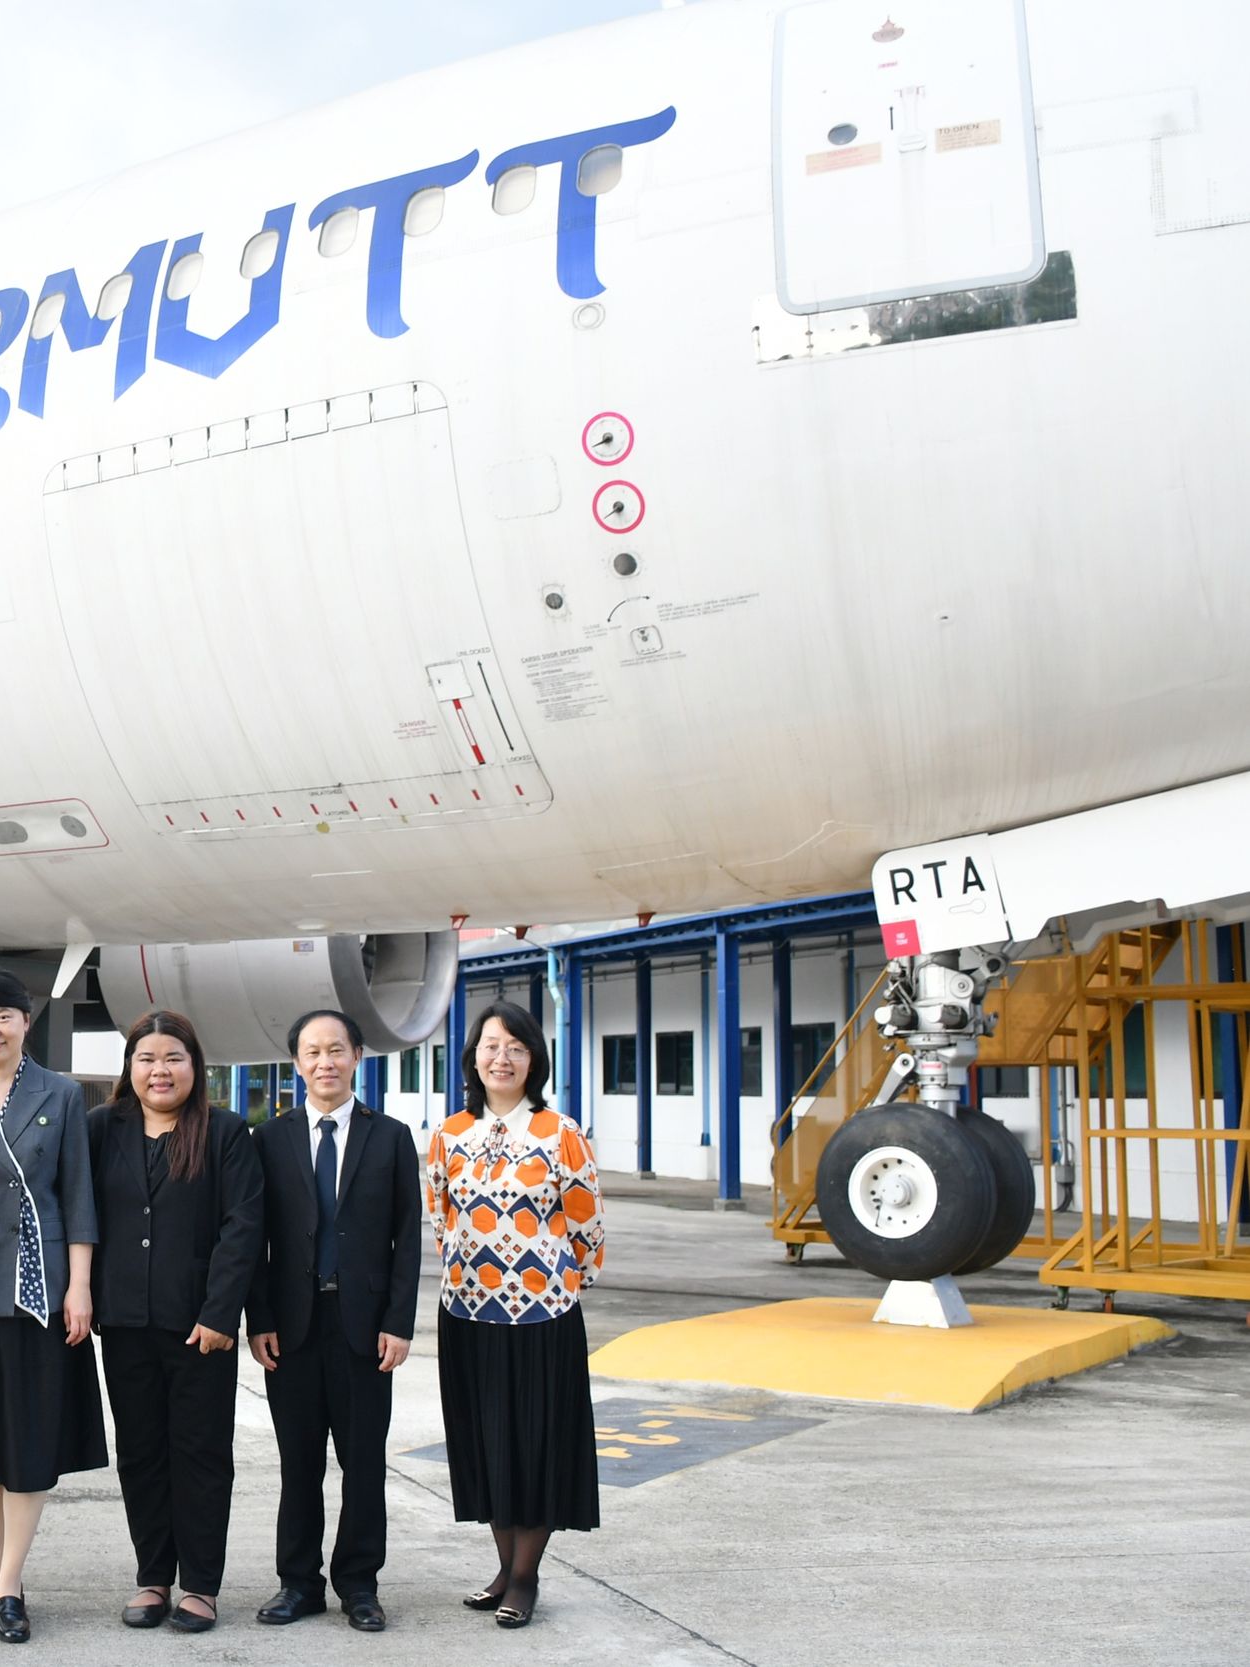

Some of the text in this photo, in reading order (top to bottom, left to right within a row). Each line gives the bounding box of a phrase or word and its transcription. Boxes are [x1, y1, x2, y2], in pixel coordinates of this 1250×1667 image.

[456, 646, 491, 658] UNLOCKED
[559, 646, 593, 657] OPERATION
[398, 720, 427, 729] DANGER
[506, 754, 533, 763] LOCKED
[889, 856, 986, 905] RTA
